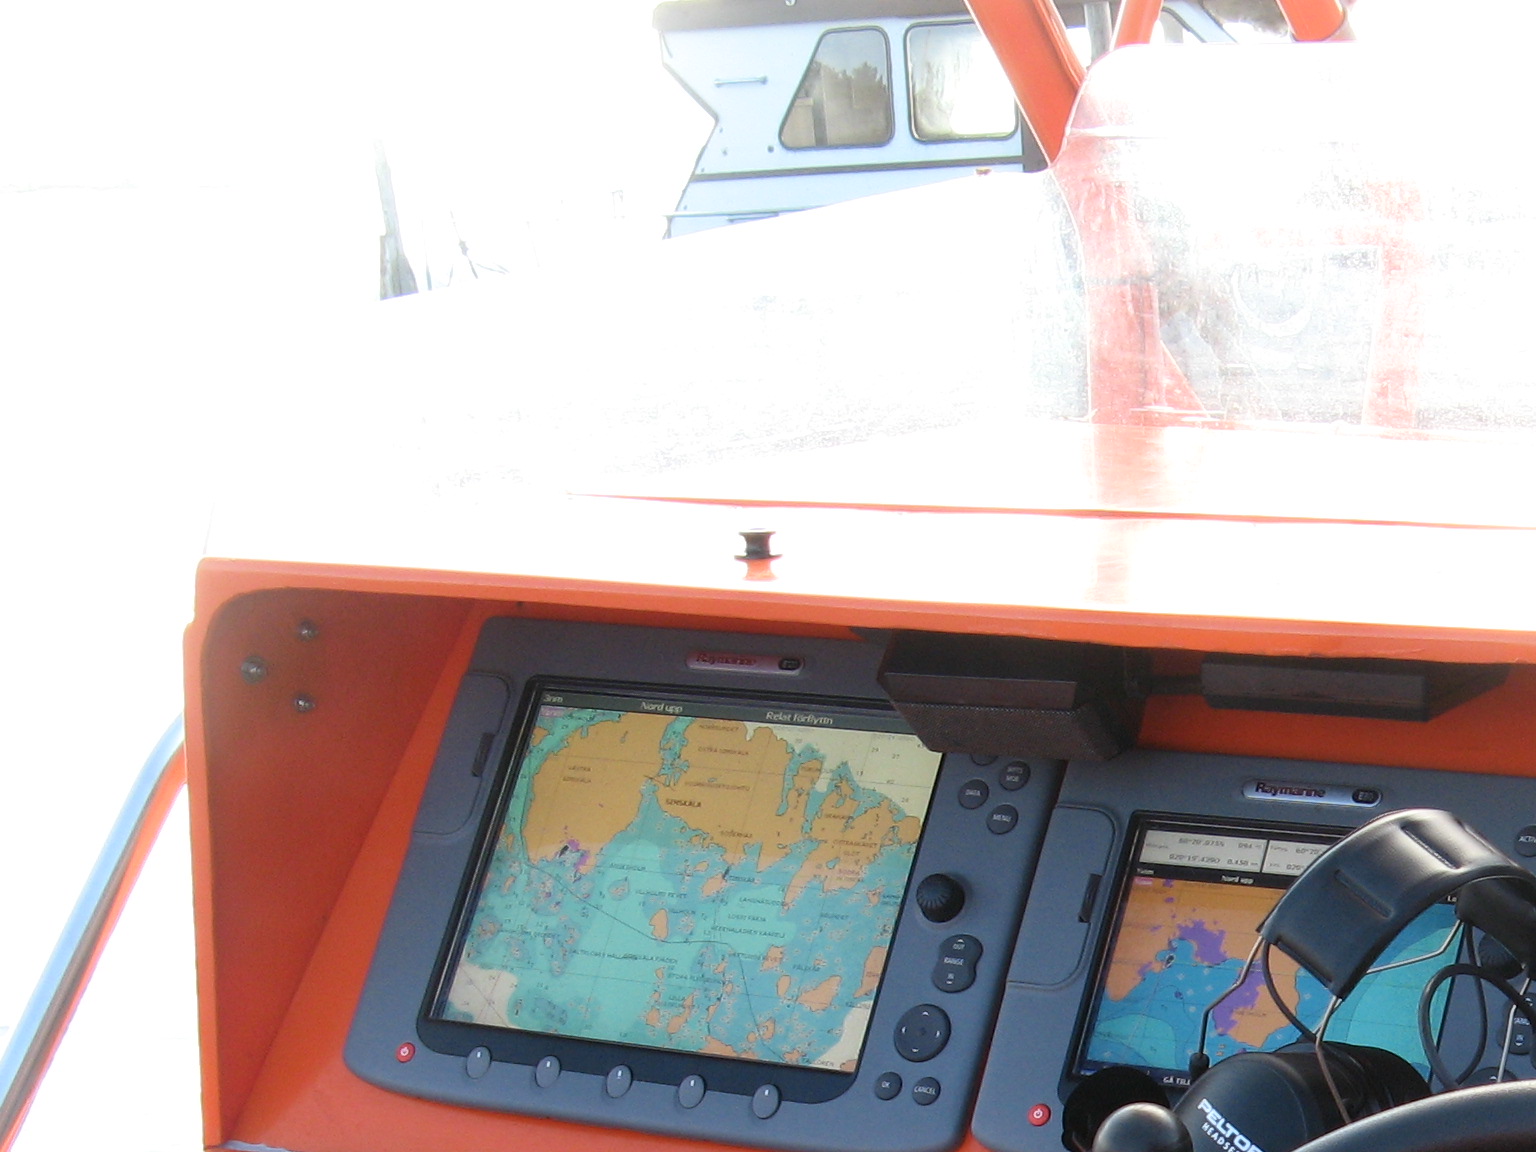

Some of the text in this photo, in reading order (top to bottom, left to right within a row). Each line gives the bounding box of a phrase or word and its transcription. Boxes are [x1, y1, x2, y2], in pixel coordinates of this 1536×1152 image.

[640, 702, 683, 714] Nord upp
[1255, 782, 1326, 798] Raymarine
[881, 1080, 891, 1088] OK
[914, 1084, 937, 1096] CANCEL
